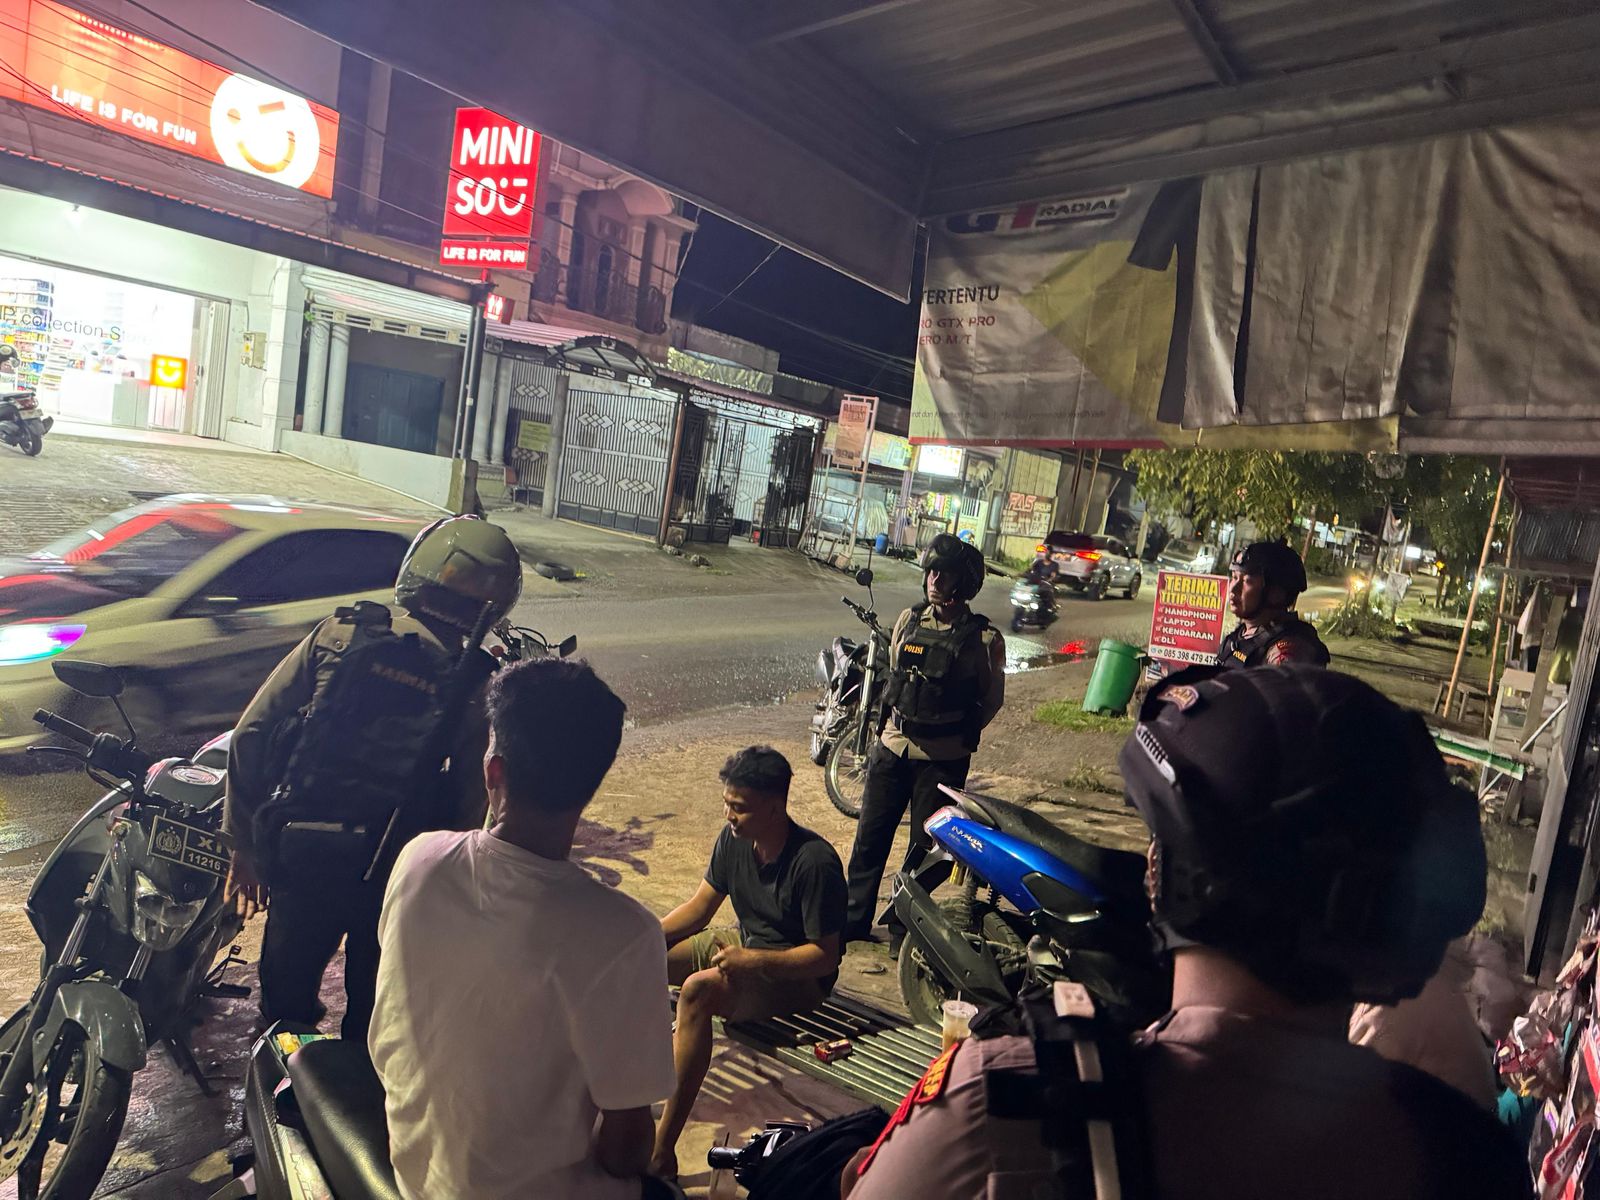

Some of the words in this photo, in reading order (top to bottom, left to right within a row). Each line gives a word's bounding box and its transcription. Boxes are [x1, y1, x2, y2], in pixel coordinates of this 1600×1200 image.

[51, 84, 93, 112] LIFE
[98, 100, 117, 119] IS
[121, 108, 158, 133] FOR
[162, 121, 197, 145] FUN
[459, 125, 534, 166] MINI
[1041, 199, 1115, 216] RADIAL
[443, 246, 465, 260] LIFE
[467, 247, 478, 261] IS
[479, 249, 501, 262] FOR
[503, 249, 525, 263] FUN
[922, 285, 999, 304] ERTENTU
[22, 308, 103, 338] collection
[937, 318, 964, 329] GTX
[968, 315, 996, 328] PRO
[1166, 575, 1218, 596] TERIMA
[1161, 592, 1186, 605] TITIP
[1189, 595, 1221, 610] GADAI
[1163, 617, 1196, 627] LAPTOP
[1164, 607, 1217, 621] HANDPHONE
[1161, 636, 1176, 645] DLL
[1162, 626, 1214, 640] KENDARAAN
[1164, 648, 1176, 657] 085
[1177, 651, 1190, 661] 398
[188, 853, 221, 871] 11216
